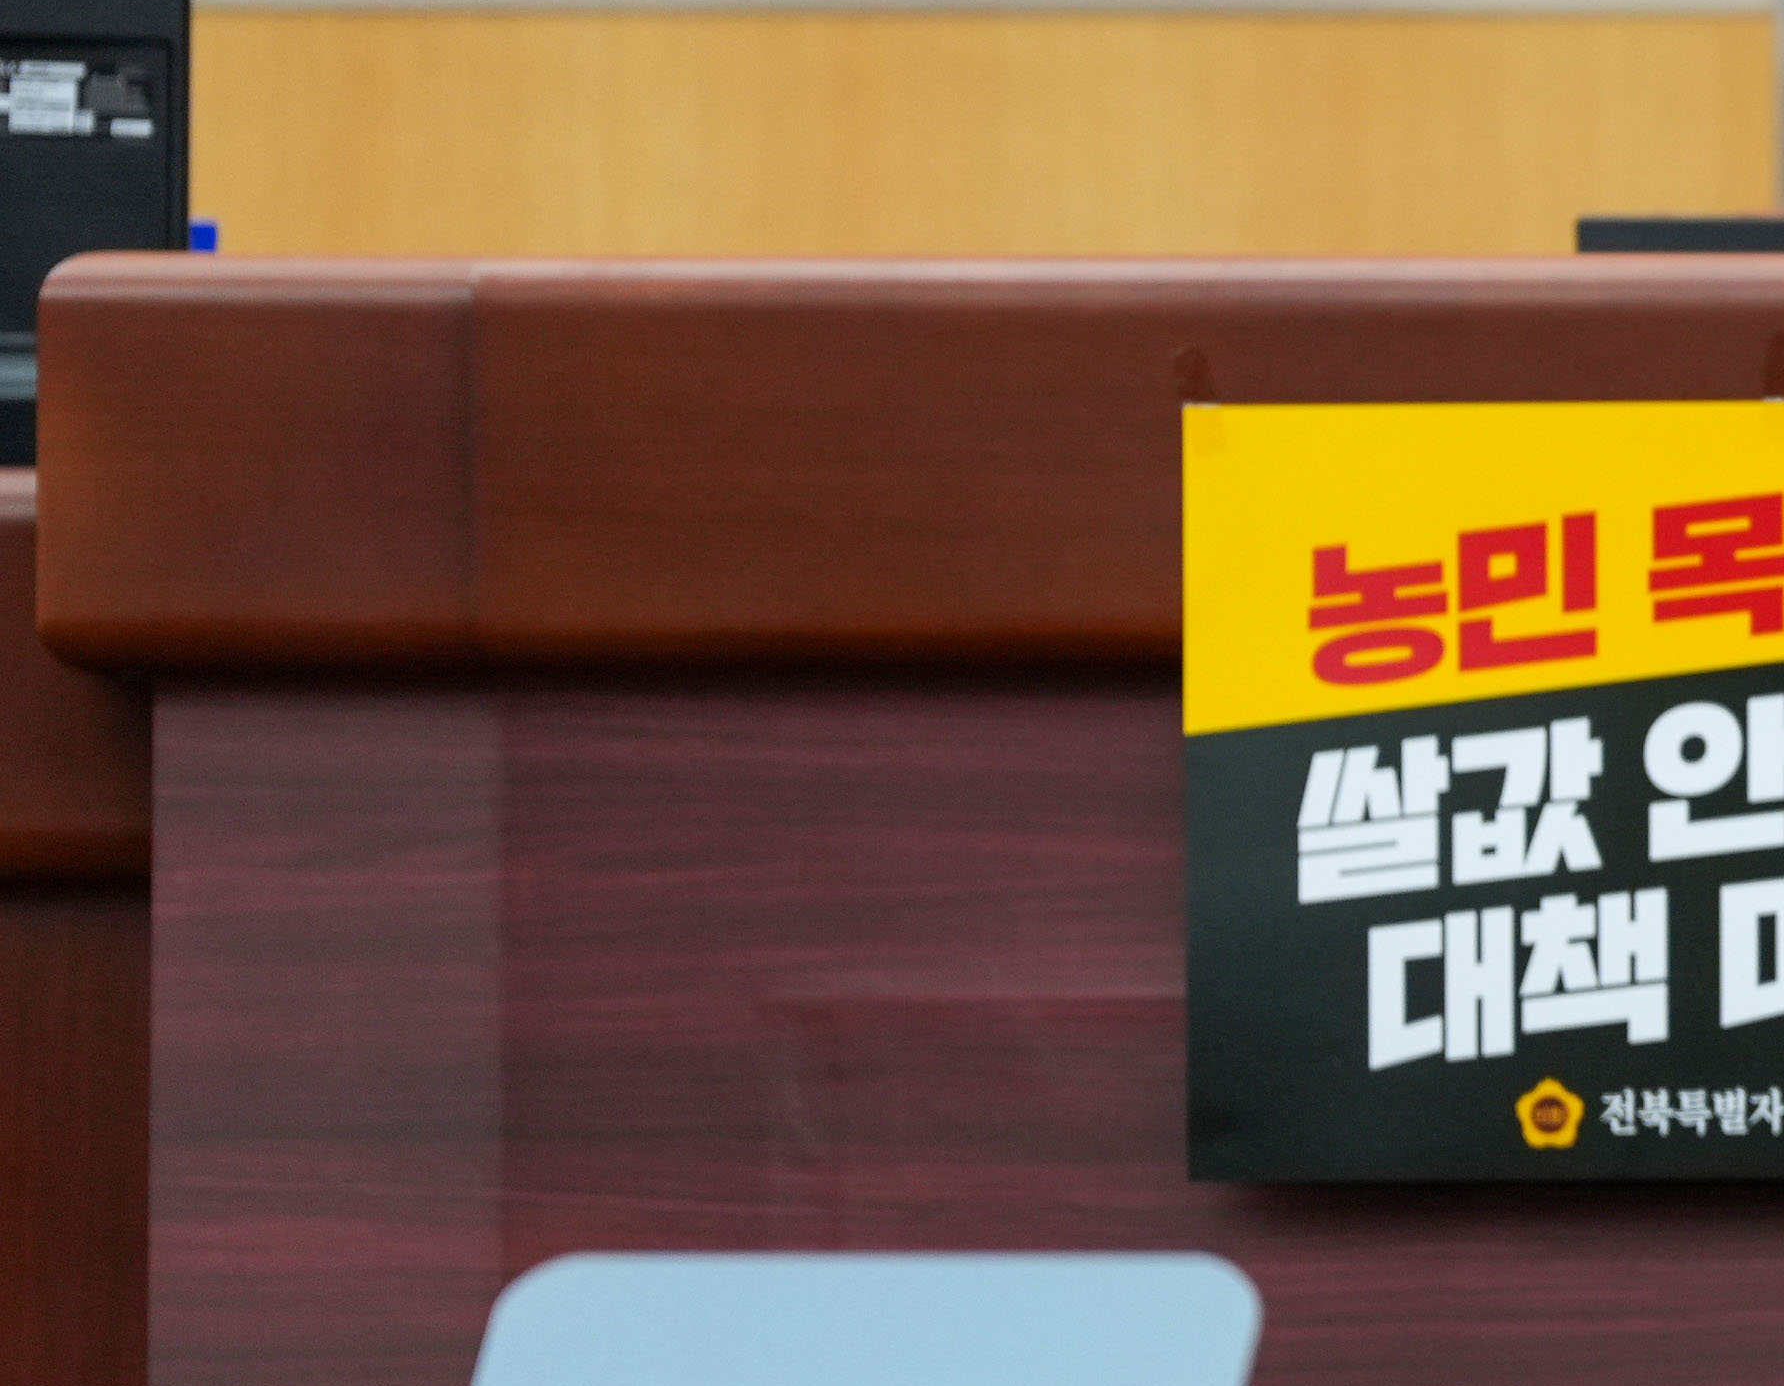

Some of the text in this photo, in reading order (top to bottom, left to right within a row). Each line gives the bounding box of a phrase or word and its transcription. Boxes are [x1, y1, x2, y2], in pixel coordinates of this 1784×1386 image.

[1308, 511, 1598, 687] 농민
[1298, 717, 1602, 903] 쌀값
[1368, 887, 1669, 1070] 대책
